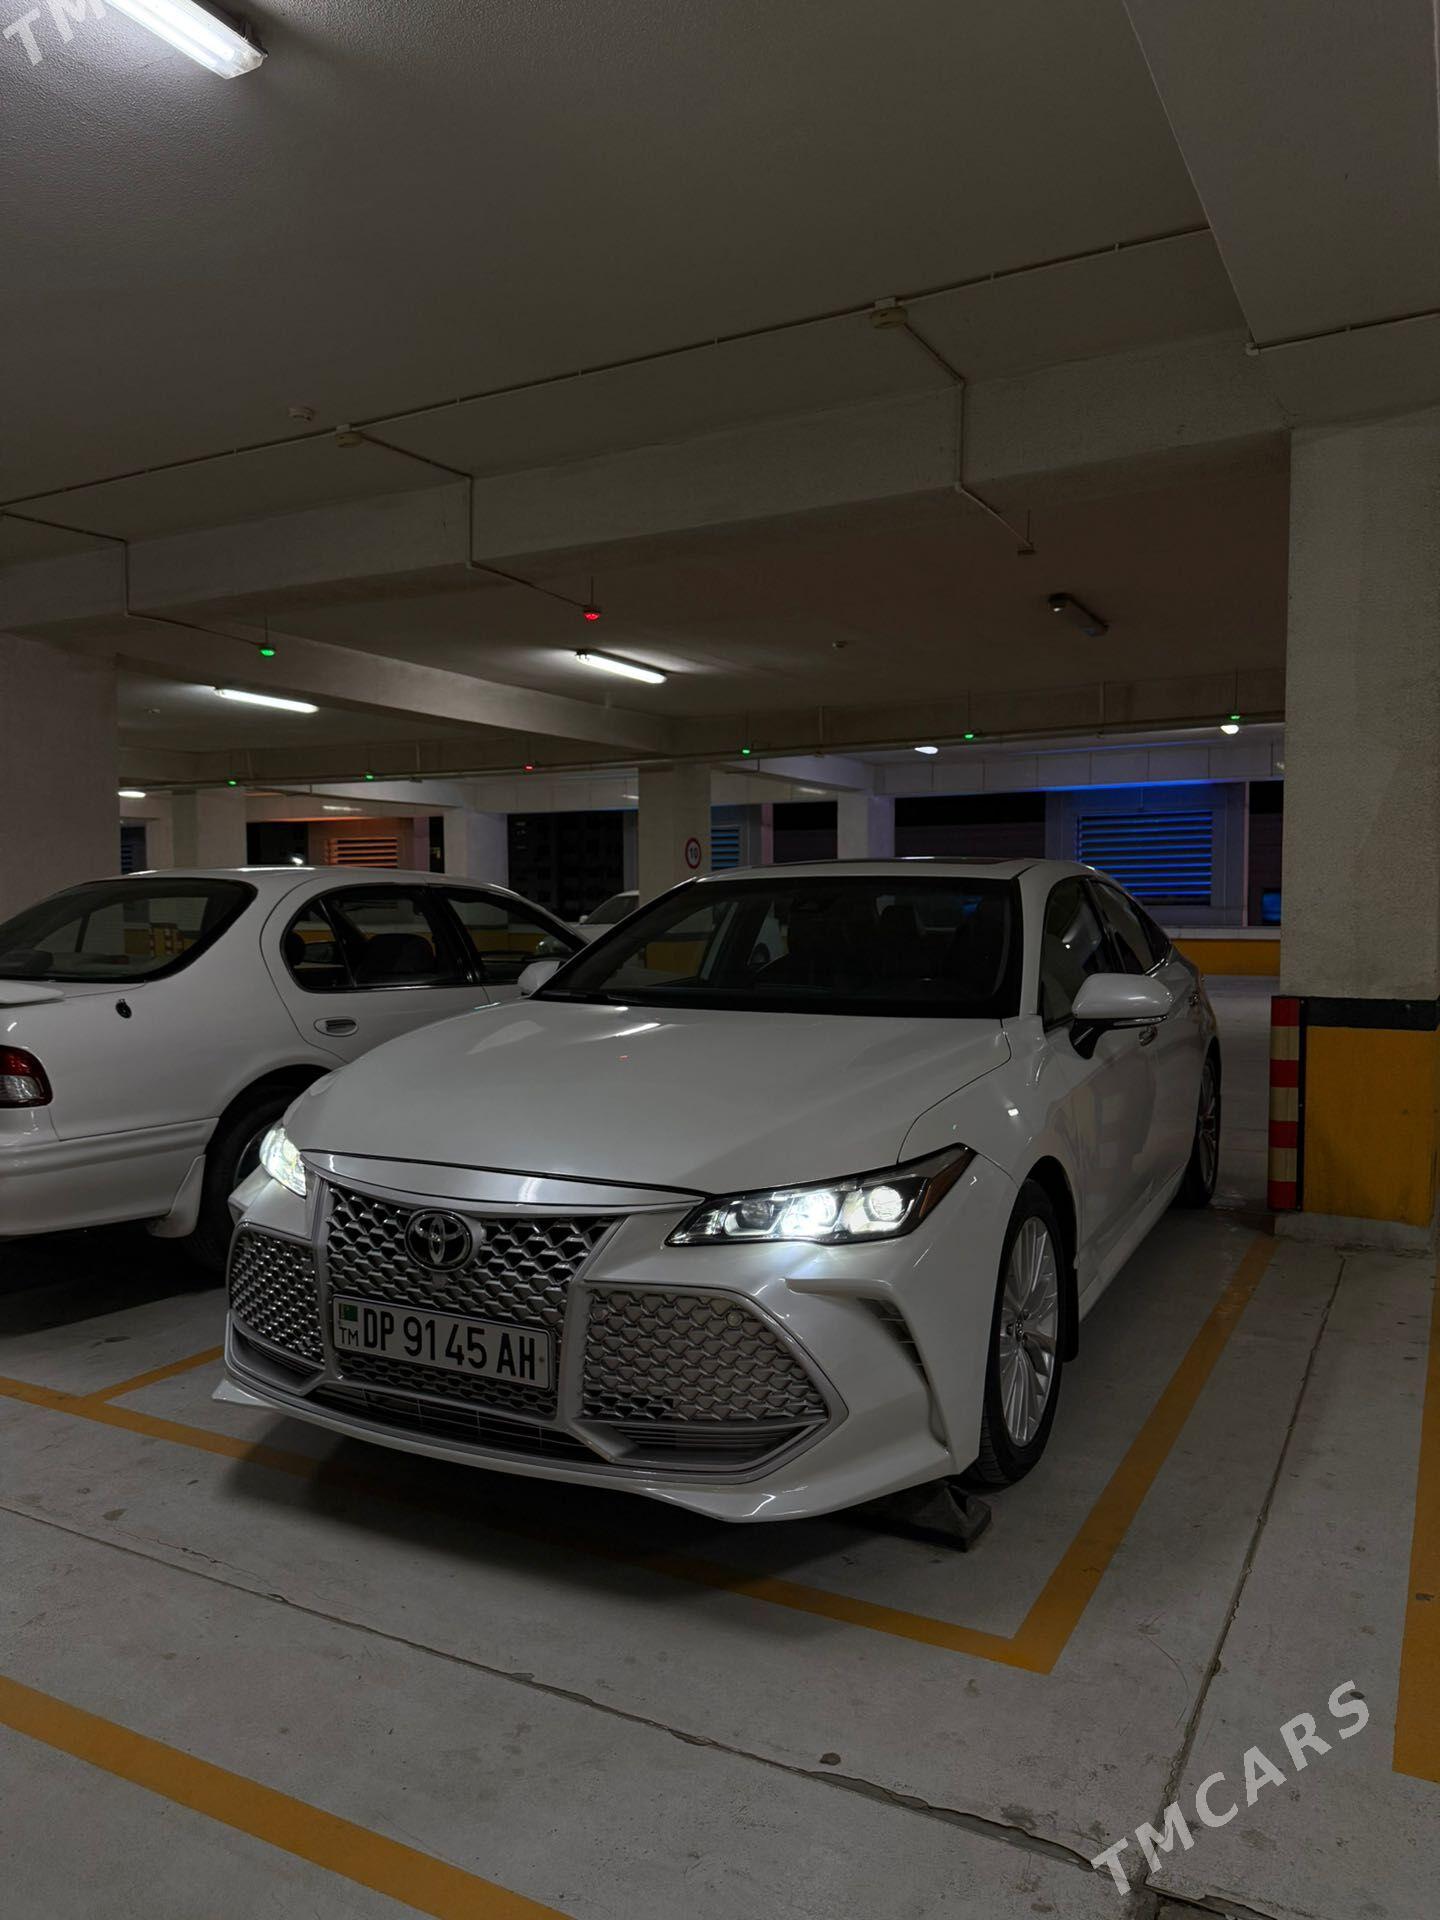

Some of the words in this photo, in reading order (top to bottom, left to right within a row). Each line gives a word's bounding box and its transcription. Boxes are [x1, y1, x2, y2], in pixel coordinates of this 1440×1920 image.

[339, 1327, 358, 1347] TM
[364, 1308, 394, 1351] DP
[496, 1333, 535, 1380] AH
